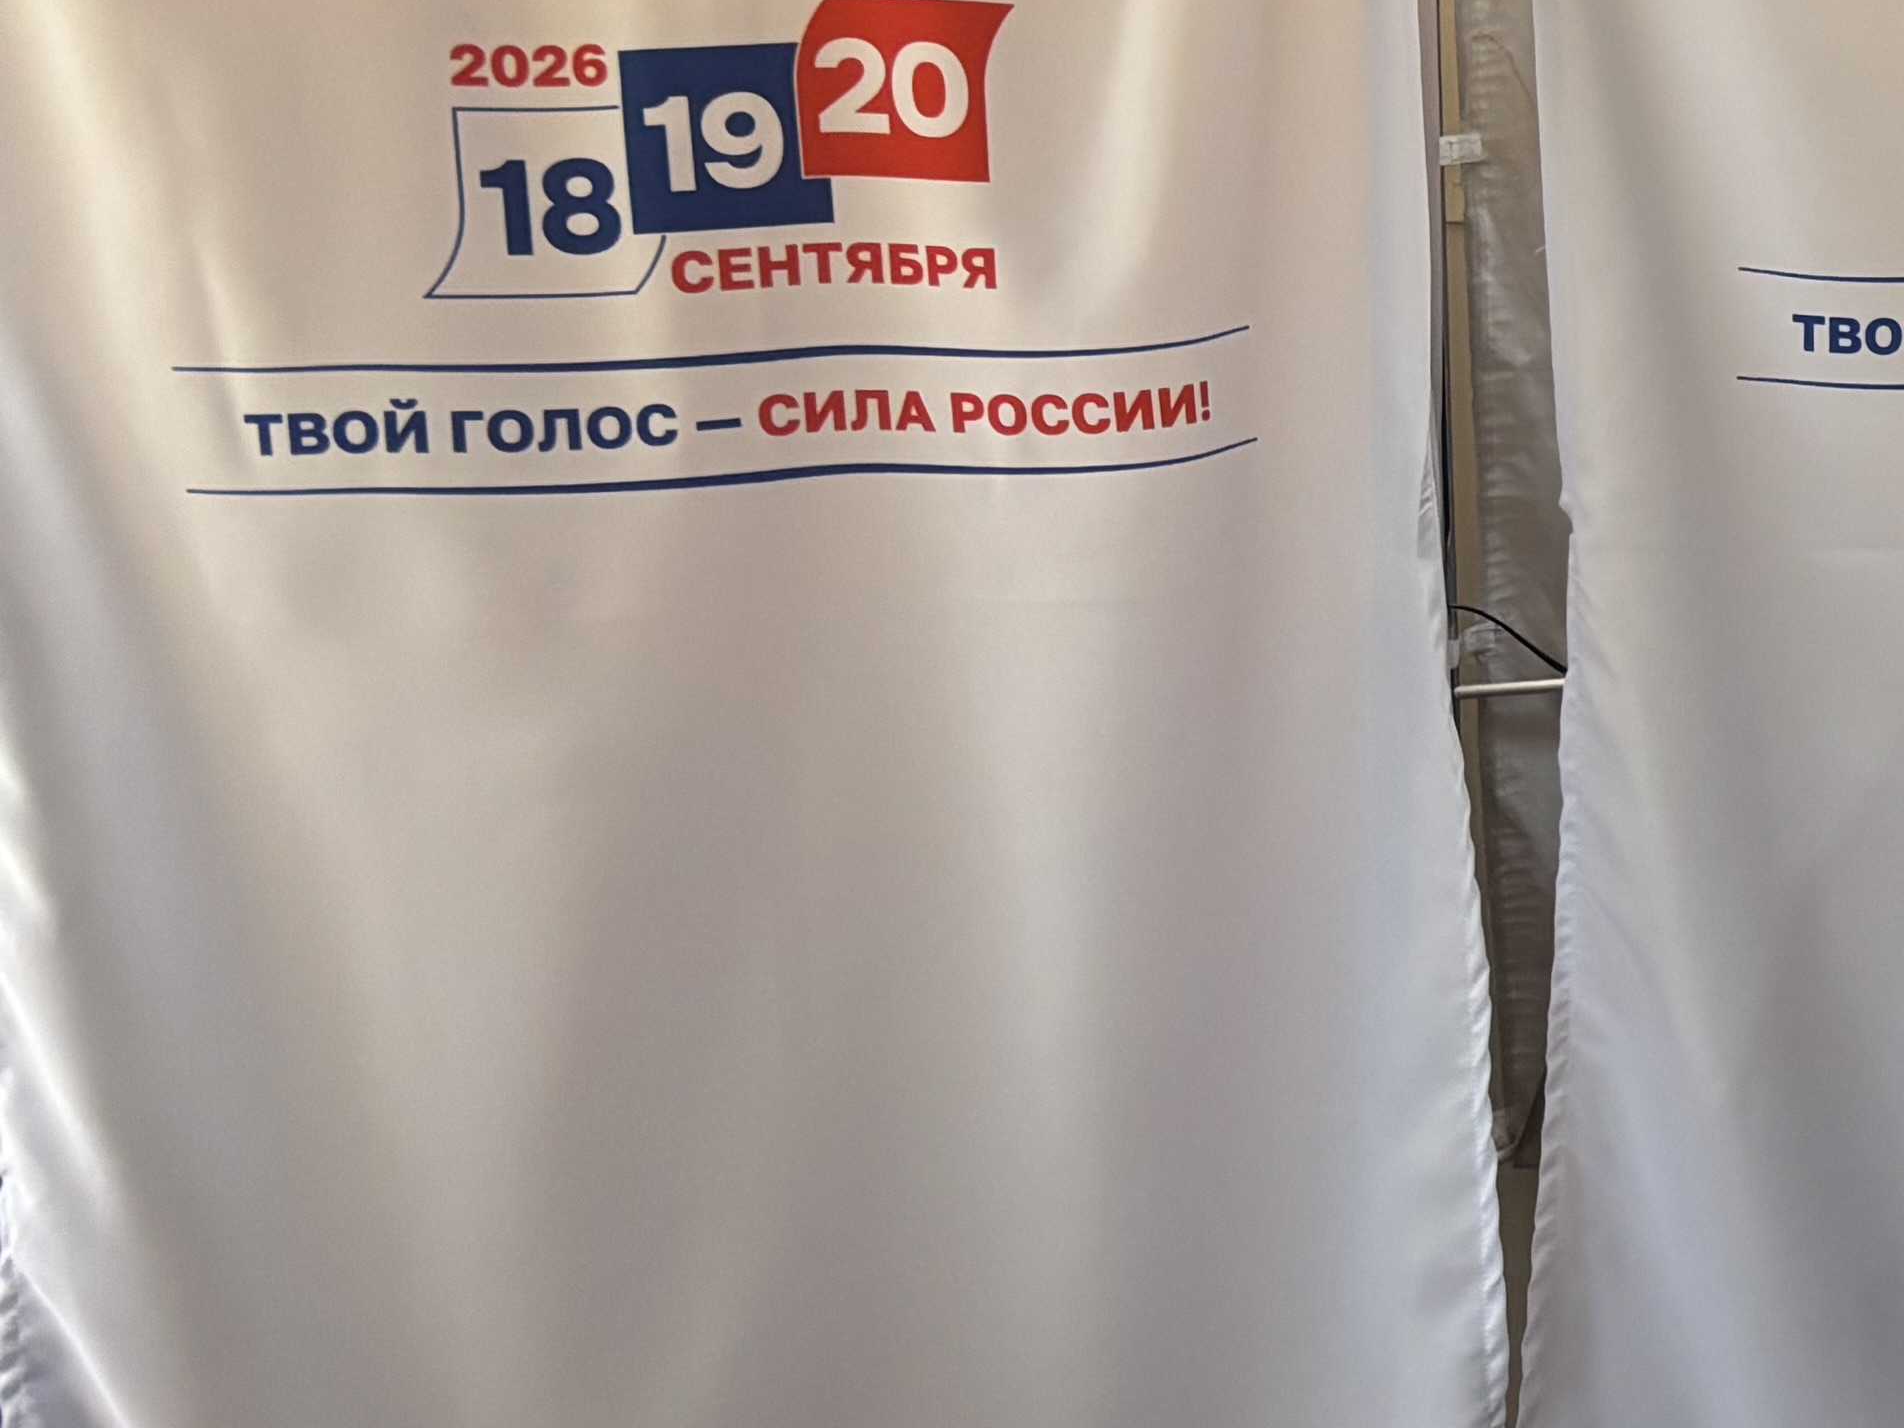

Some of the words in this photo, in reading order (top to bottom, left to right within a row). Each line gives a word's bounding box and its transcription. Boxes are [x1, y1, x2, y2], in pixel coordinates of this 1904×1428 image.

[450, 44, 607, 87] 2026
[479, 158, 621, 255] 18
[643, 92, 783, 191] 19
[815, 38, 968, 137] 20
[671, 242, 996, 293] СЕНТЯБРЯ
[244, 399, 429, 455] ТВОЙ
[451, 404, 677, 453] ГОЛОС
[759, 390, 935, 436] СИЛА
[951, 381, 1210, 435] РОССИИ!
